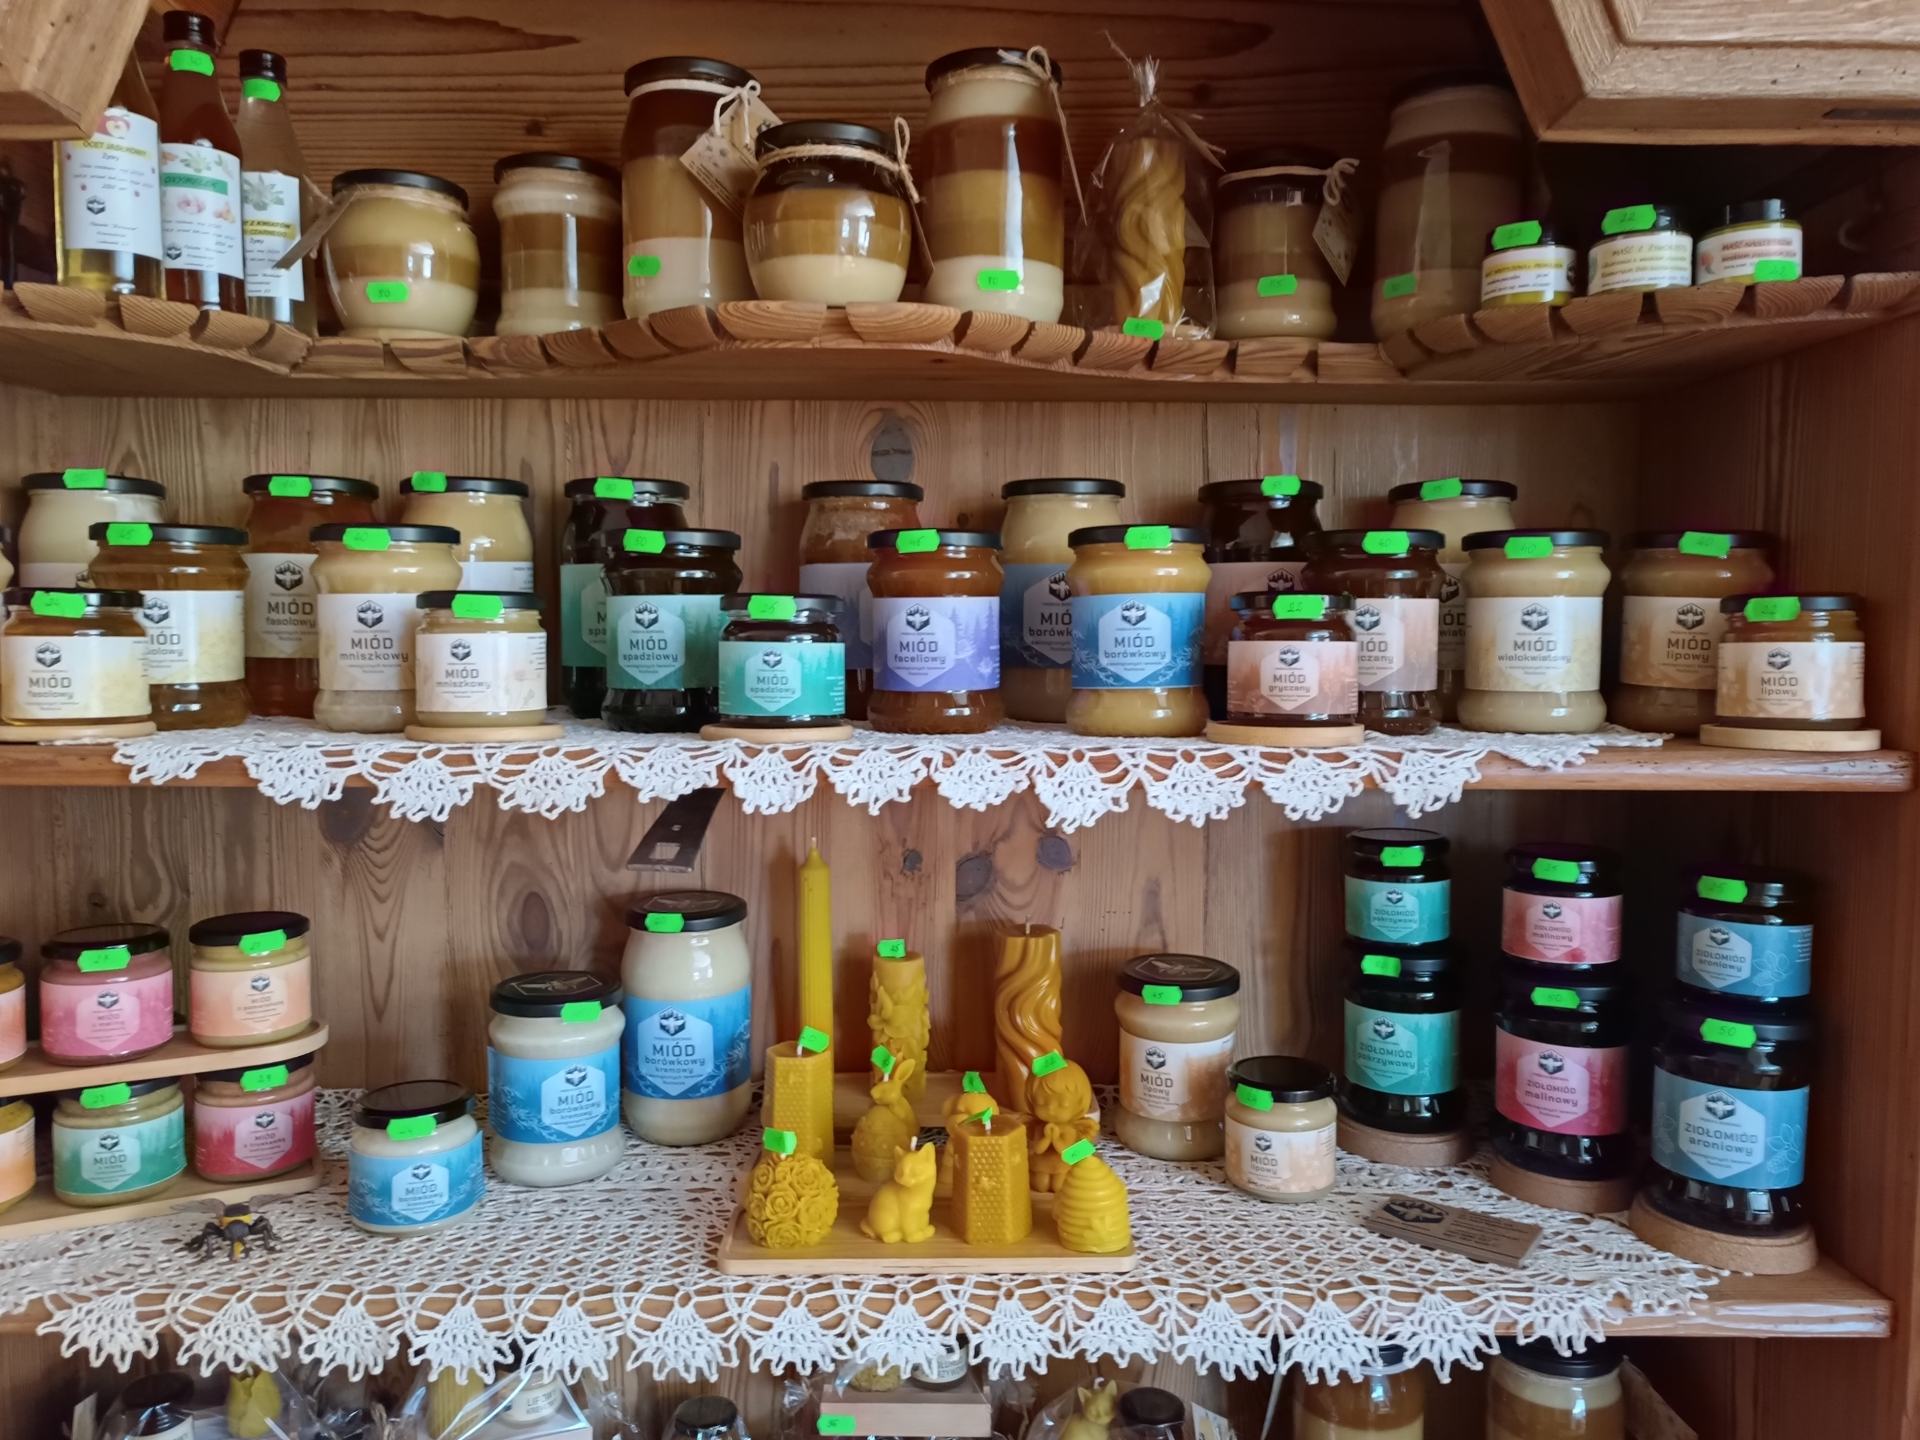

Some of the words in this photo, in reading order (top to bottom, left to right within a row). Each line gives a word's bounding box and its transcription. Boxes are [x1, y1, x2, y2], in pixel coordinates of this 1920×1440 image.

[267, 598, 314, 615] MIÓD
[266, 616, 317, 629] fasolowy
[1040, 609, 1073, 626] MIÓ
[150, 630, 181, 646] IÓD
[1028, 625, 1073, 637] borówk
[351, 634, 393, 650] MIÓD
[630, 635, 668, 651] MIÓD
[899, 637, 938, 653] MIÓD
[1114, 632, 1154, 648] MIÓD
[1360, 638, 1388, 653] IÓD
[1513, 636, 1557, 652] MIÓD
[1667, 635, 1712, 651] MIÓD
[339, 650, 409, 663] mniszkowy
[623, 651, 679, 663] spadziowy
[894, 653, 946, 665] faceliowy
[1103, 649, 1167, 660] borówkowy
[1666, 650, 1710, 664] lipowy
[445, 664, 479, 679] MIÓD
[756, 670, 788, 686] MIÓD
[1273, 669, 1306, 684] MIÓD
[1760, 672, 1799, 687] MIÓD
[28, 672, 72, 688] MIÓD
[1760, 686, 1798, 697] lipowy
[653, 1041, 696, 1057] MIÓD
[644, 1056, 706, 1067] borówkowy
[1141, 1072, 1173, 1088] MIÓD
[558, 1090, 594, 1106] MIÓD
[1525, 1090, 1578, 1108] malinowy
[1685, 1122, 1758, 1144] ZIOŁOMIÓD
[1688, 1136, 1753, 1157] aroniowy
[93, 1153, 127, 1165] MIÓD
[1250, 1154, 1278, 1167] MIÓD
